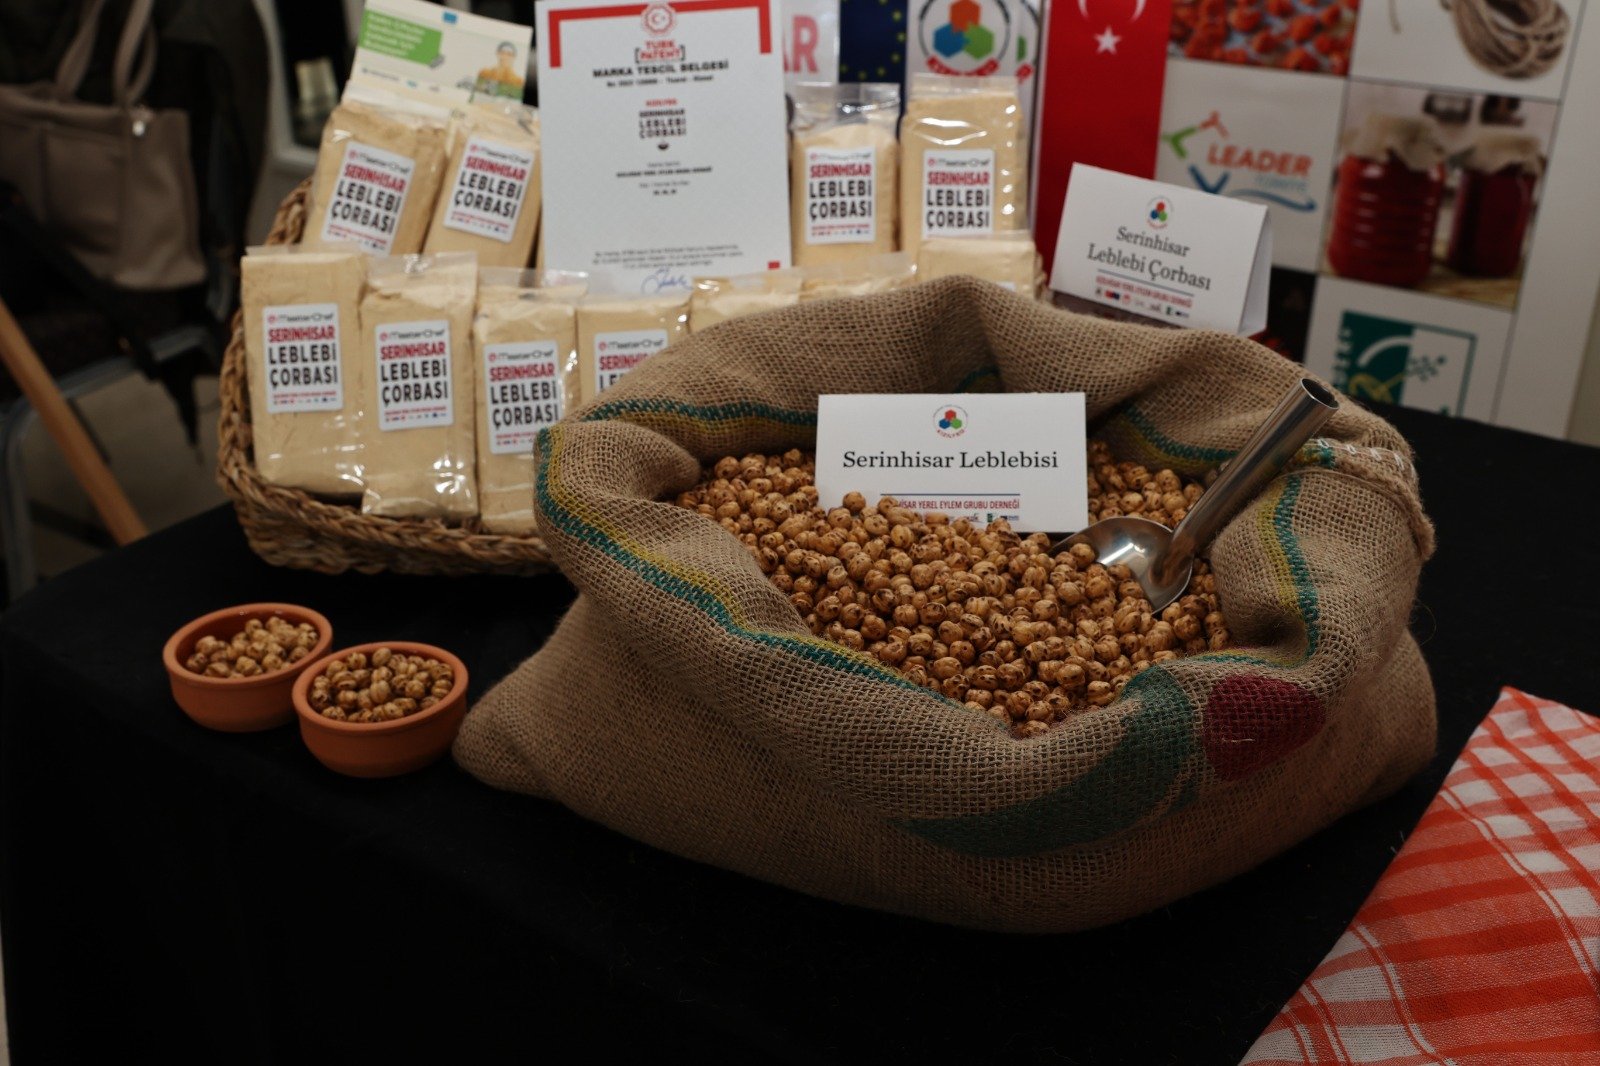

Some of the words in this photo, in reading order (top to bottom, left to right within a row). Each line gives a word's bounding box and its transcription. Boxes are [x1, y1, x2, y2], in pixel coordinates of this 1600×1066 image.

[593, 67, 632, 78] MARKA
[1207, 144, 1313, 177] LEADER
[331, 200, 395, 235] ÇORBASI
[454, 190, 517, 220] ÇORBASI
[810, 201, 872, 222] ÇORBASI
[926, 210, 989, 230] ÇORBASI
[1116, 226, 1190, 257] Serinhisar
[1087, 243, 1146, 273] Leblebi
[1149, 259, 1211, 291] Çorbası
[270, 366, 338, 390] ÇORBASI
[382, 381, 448, 407] ÇORBASI
[493, 404, 559, 431] ÇORBASI
[843, 451, 954, 468] Serinhisar
[960, 451, 1058, 468] Leblebisi
[919, 500, 938, 509] YEREL
[940, 500, 962, 509] EYLEM
[964, 500, 988, 509] GRUBU
[990, 499, 1020, 509] DERNEĞİ
